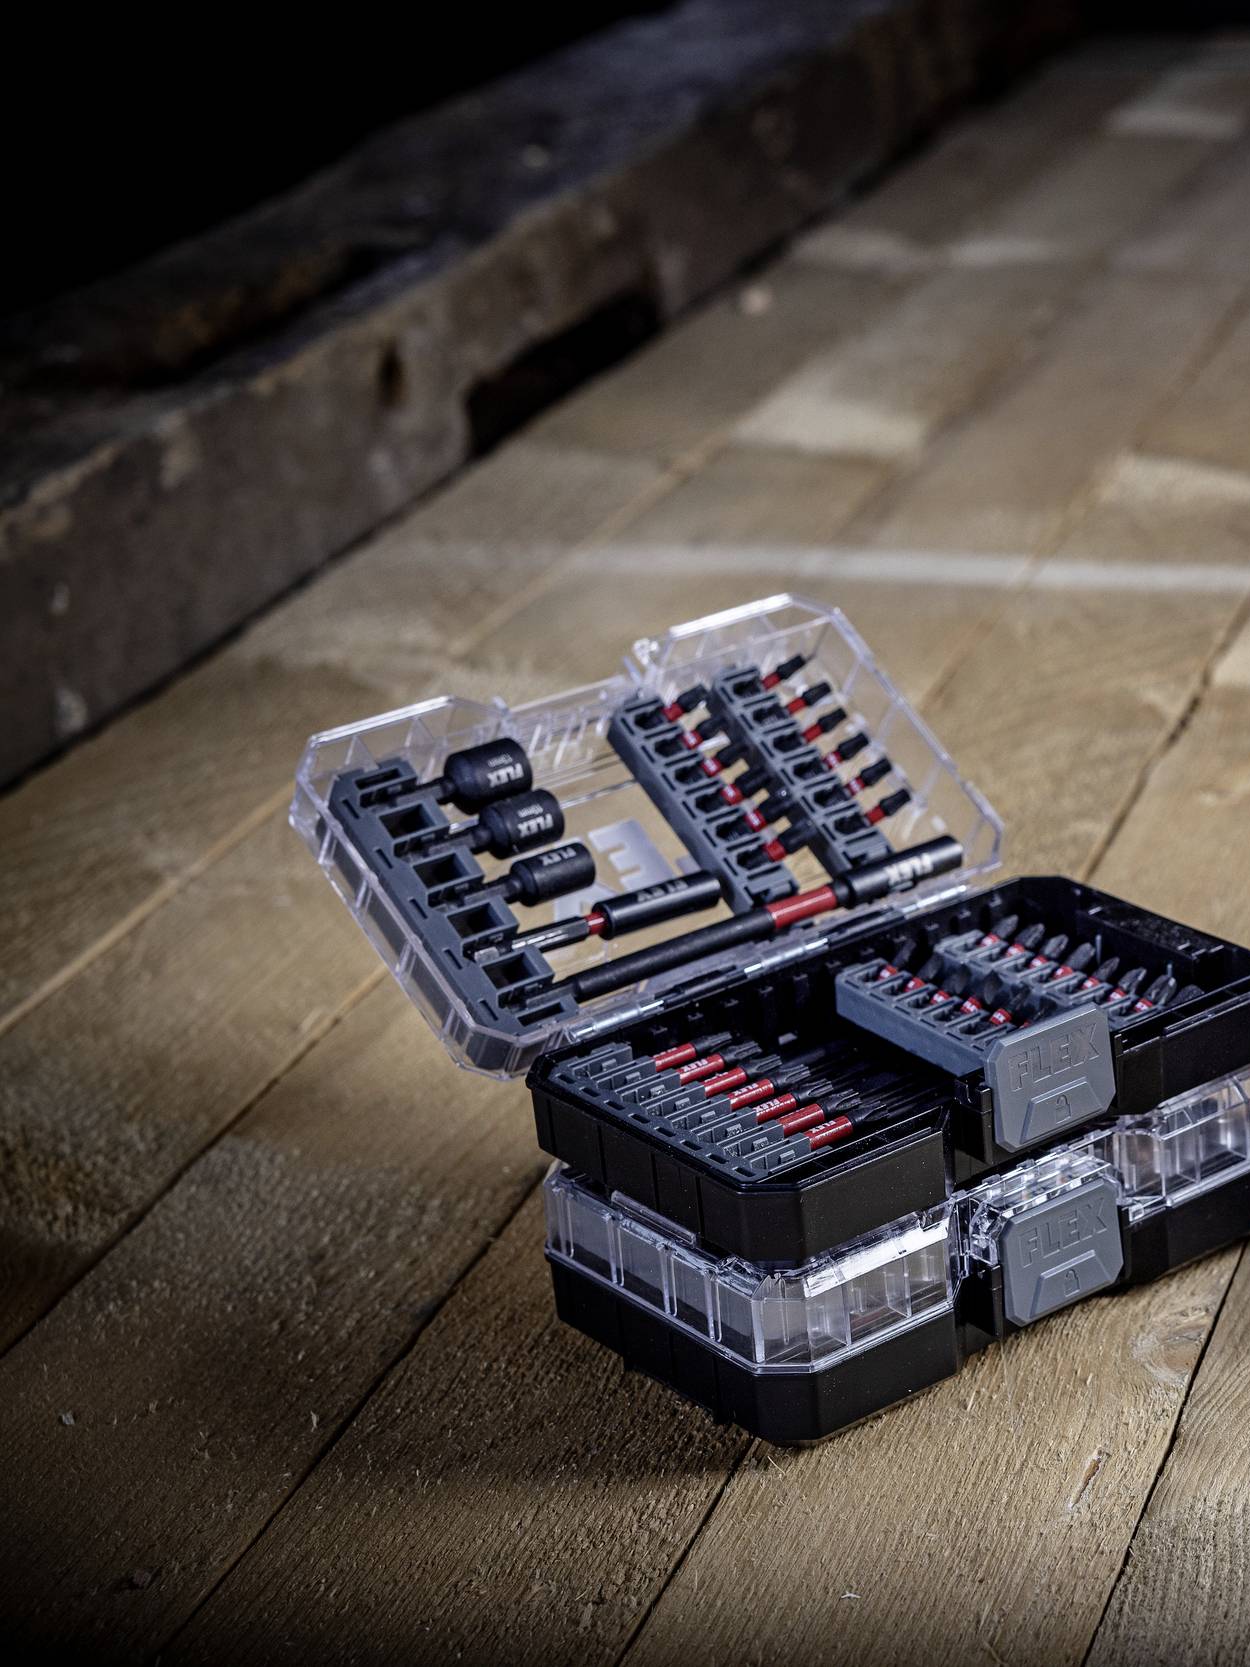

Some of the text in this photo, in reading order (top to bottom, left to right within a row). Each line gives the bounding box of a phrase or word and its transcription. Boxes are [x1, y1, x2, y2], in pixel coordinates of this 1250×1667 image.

[487, 763, 525, 788] FLEX
[517, 813, 554, 838] FLEX
[541, 847, 577, 867] FLEX
[885, 853, 934, 886] FLEX
[683, 1058, 708, 1073] FLEX
[1008, 1023, 1100, 1092] FLEX
[752, 1098, 781, 1112] FLEX
[1019, 1198, 1107, 1268] FLEX
